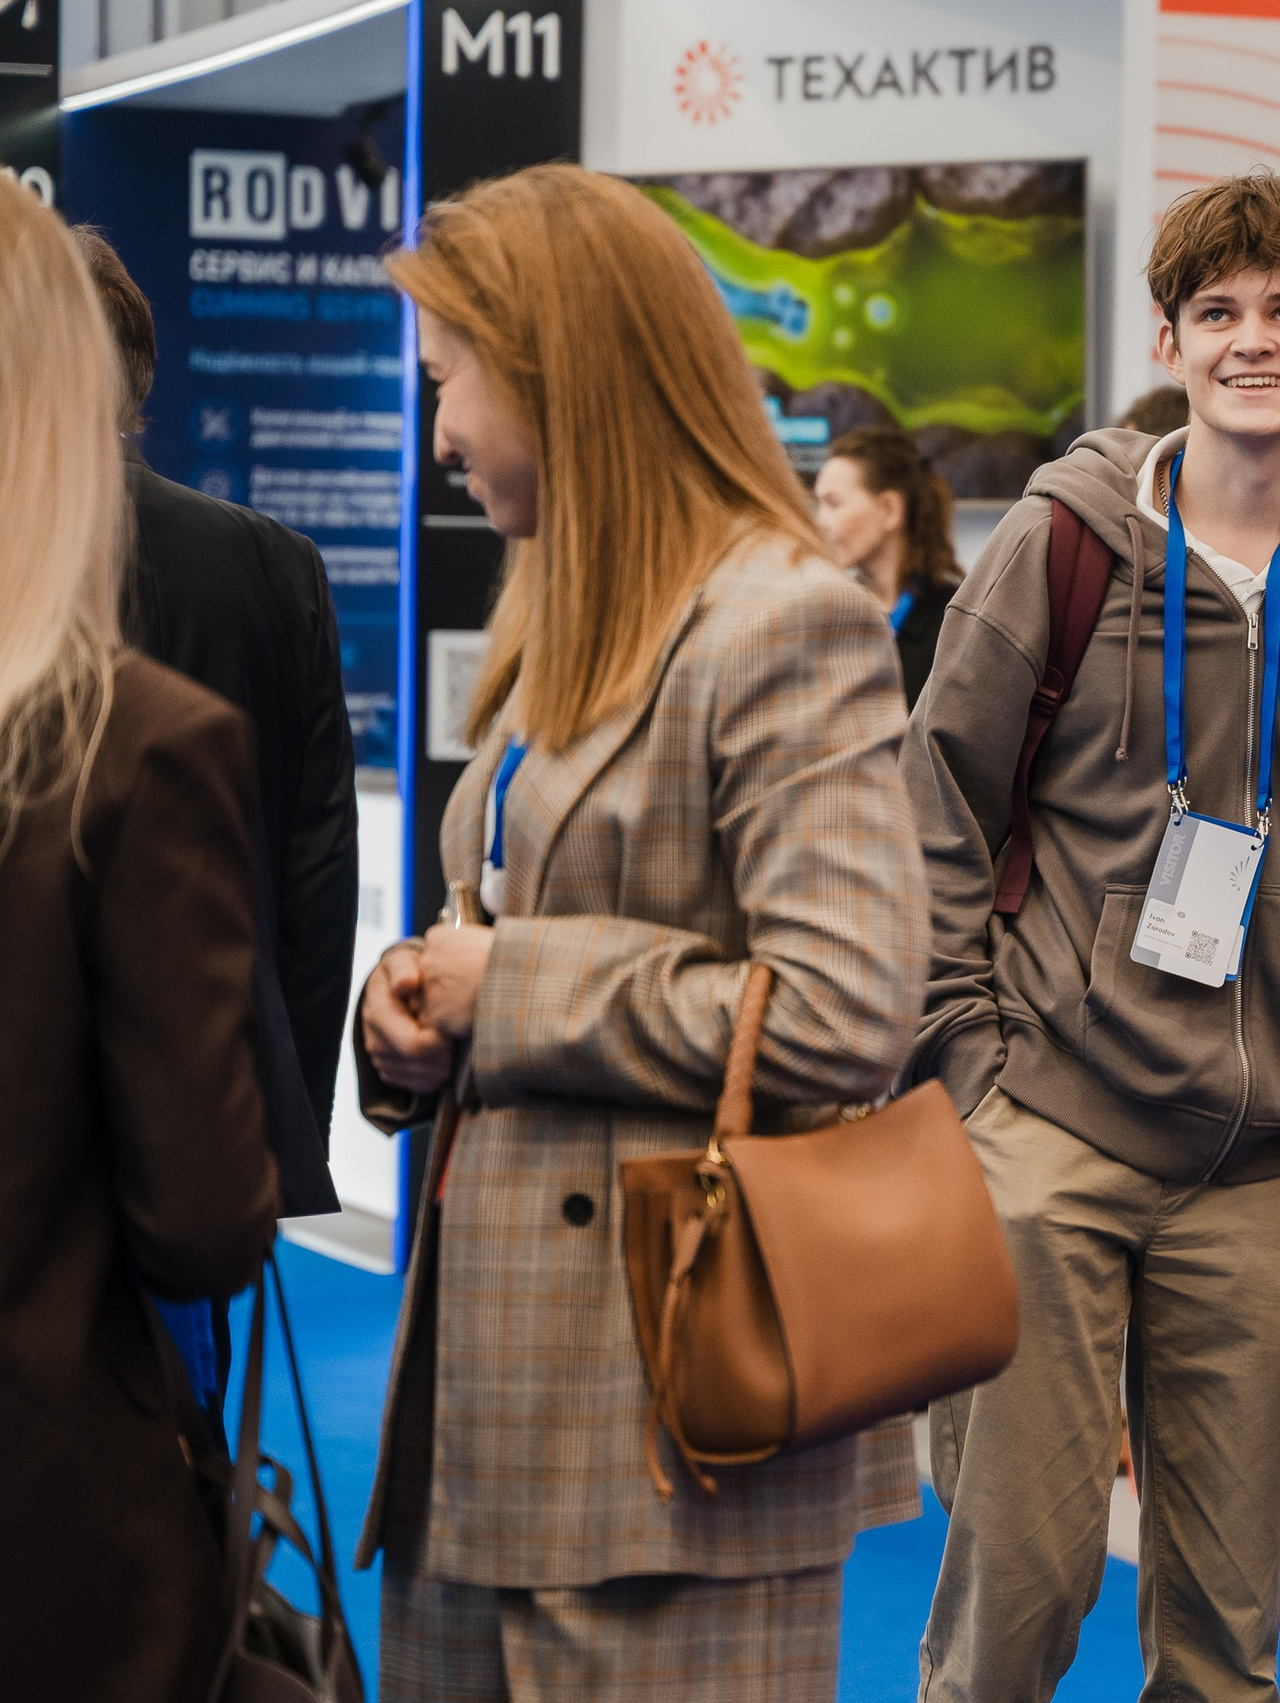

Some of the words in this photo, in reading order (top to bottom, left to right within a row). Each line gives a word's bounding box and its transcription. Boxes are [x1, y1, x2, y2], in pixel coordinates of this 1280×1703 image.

[766, 45, 1057, 102] ТЕХАКТИВ
[1159, 833, 1186, 886] VISITOR
[1149, 912, 1165, 924] Ivan
